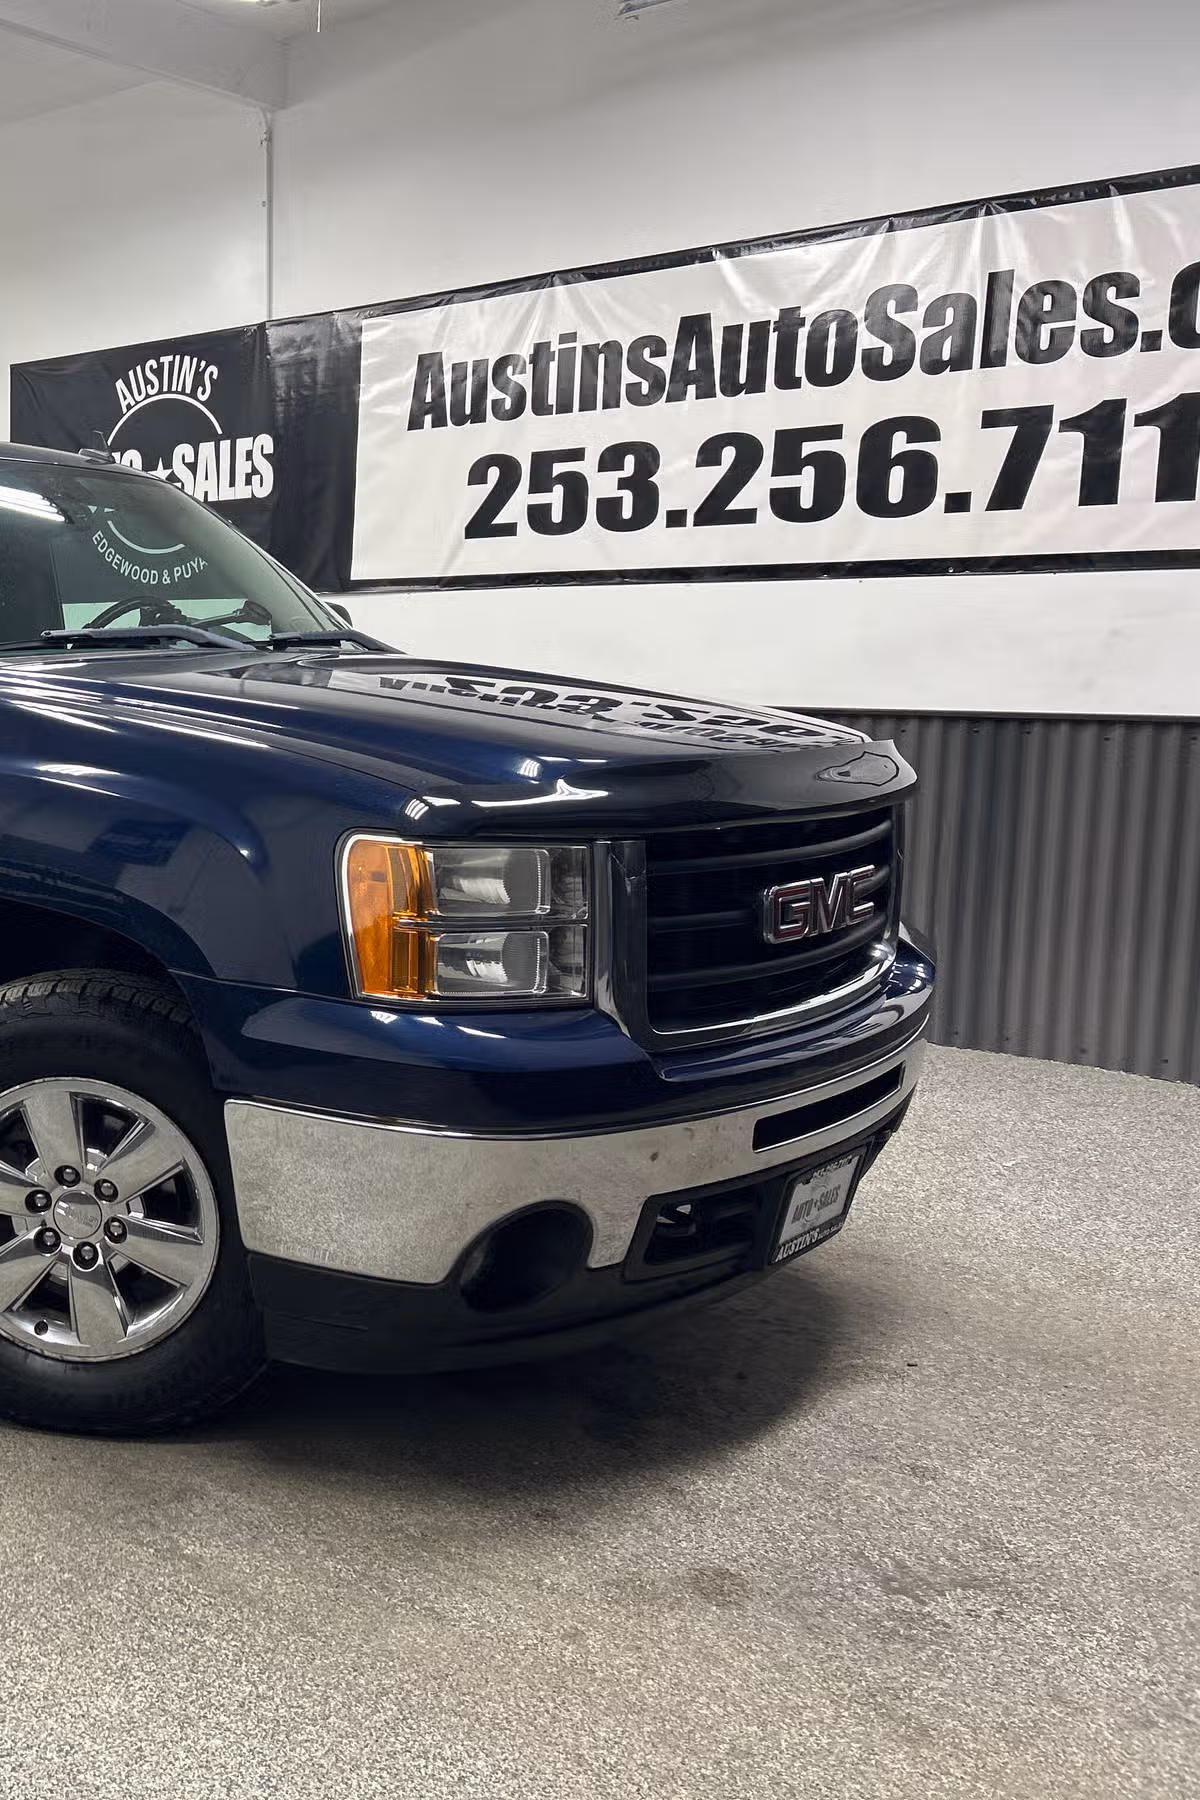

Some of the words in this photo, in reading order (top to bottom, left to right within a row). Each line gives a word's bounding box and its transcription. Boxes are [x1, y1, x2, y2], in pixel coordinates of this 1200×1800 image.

[114, 355, 219, 413] AUSTIN'S
[172, 433, 274, 502] SALES
[464, 392, 1200, 539] 253.256.711
[92, 530, 159, 584] EDGEWOOD
[162, 569, 171, 584] &
[763, 864, 876, 944] GMC
